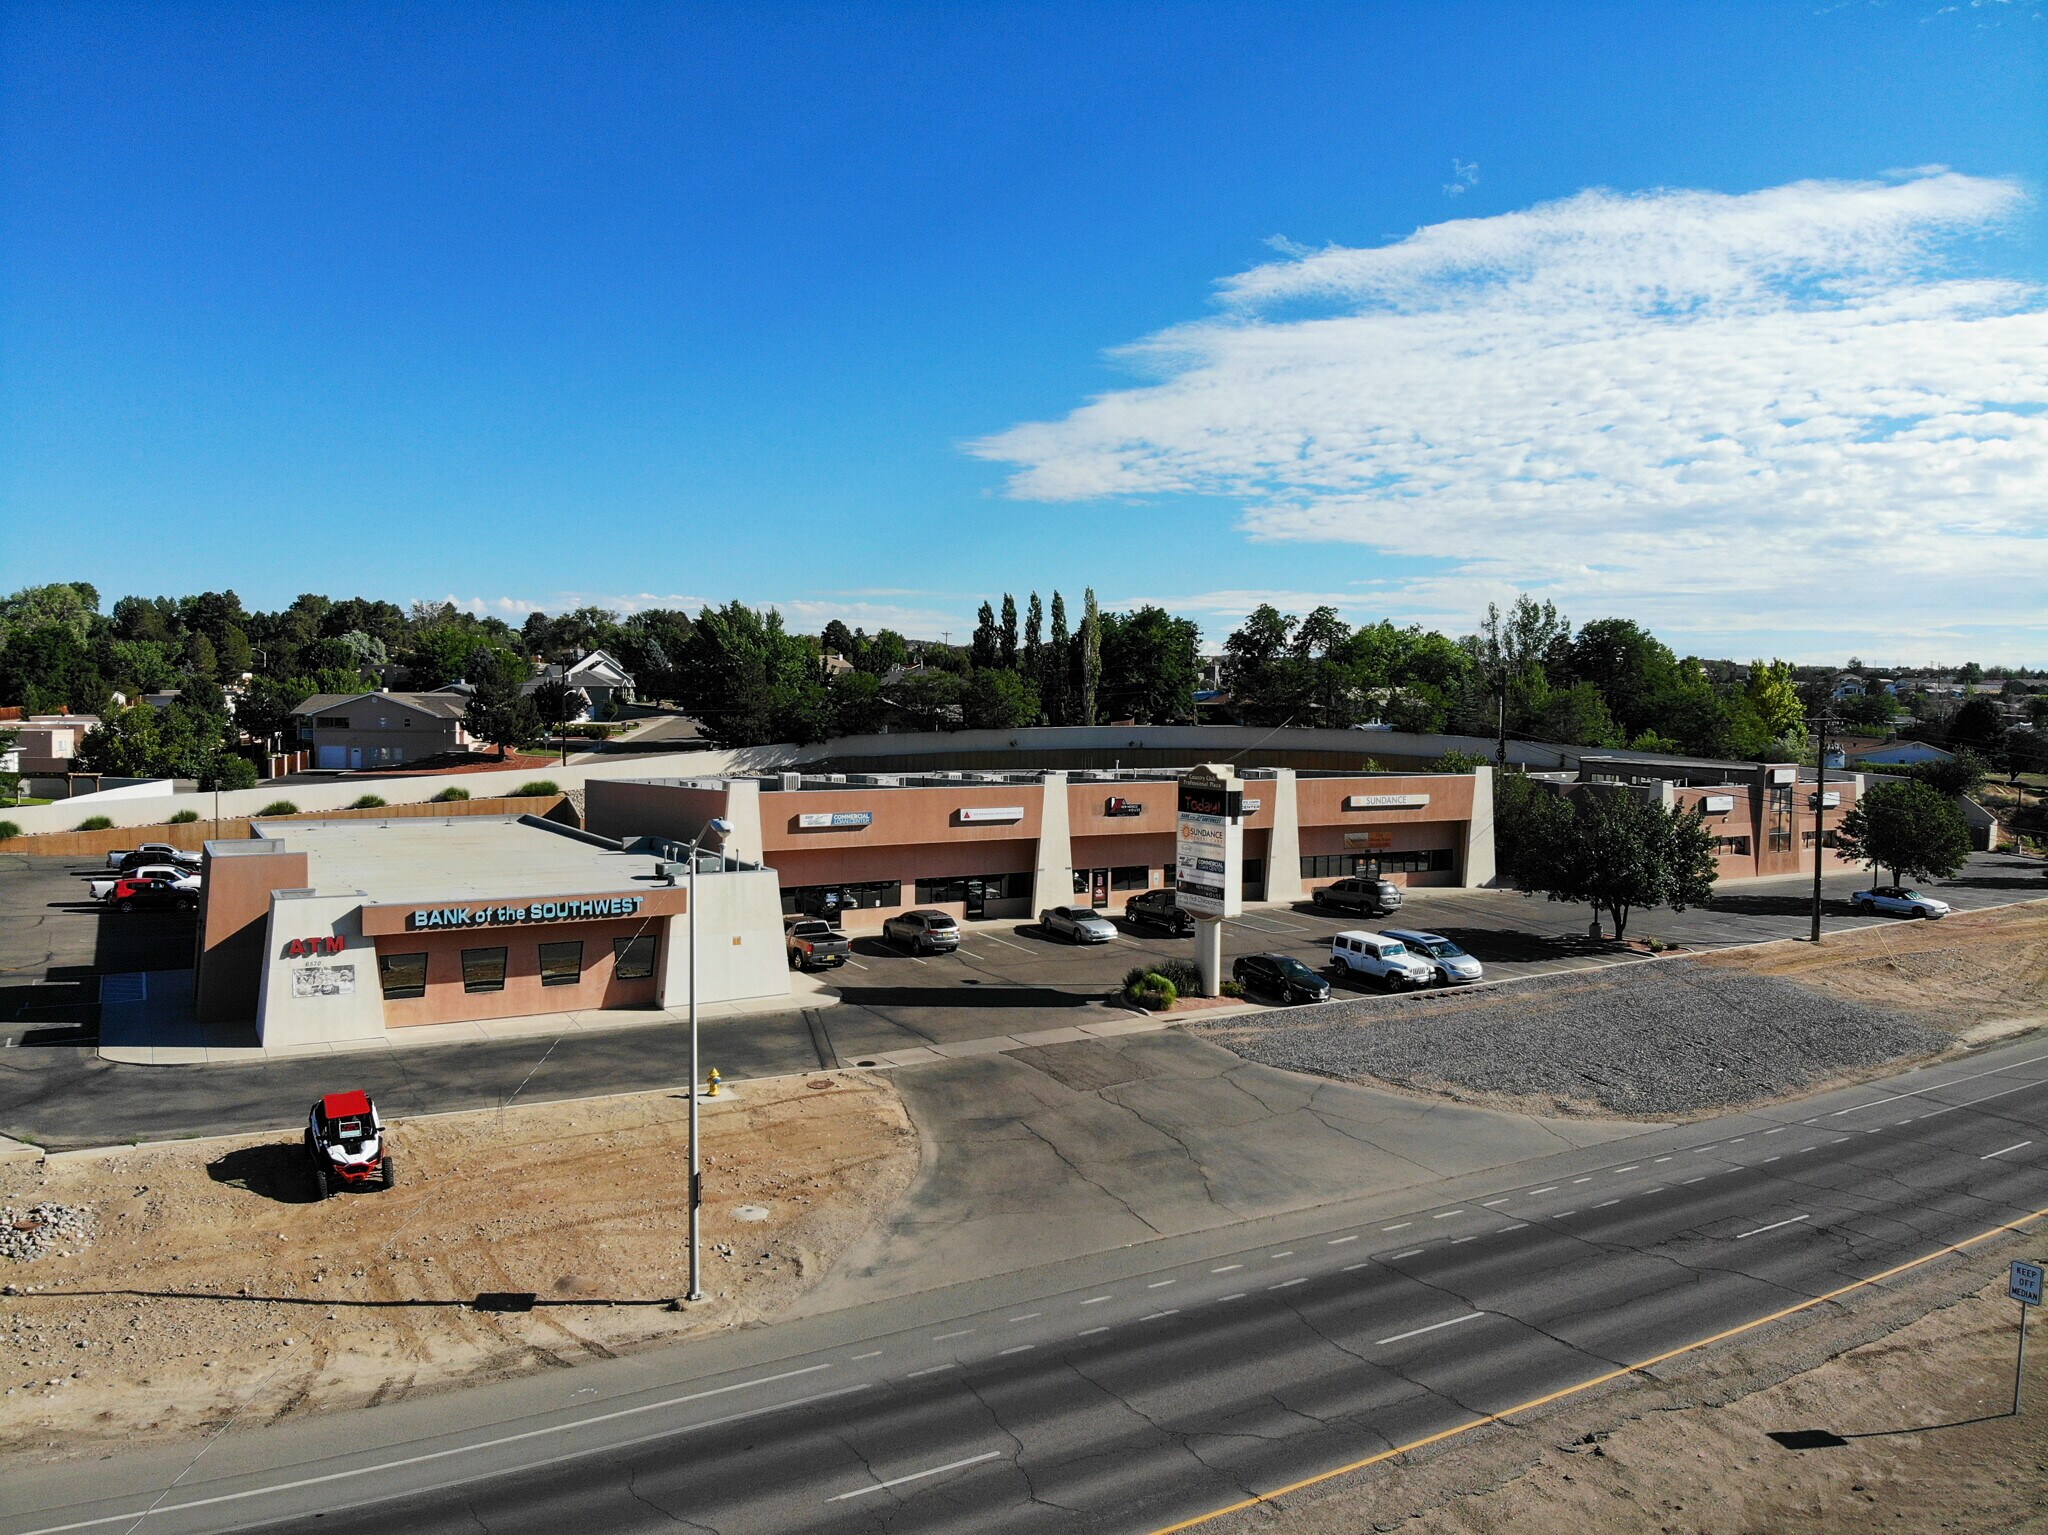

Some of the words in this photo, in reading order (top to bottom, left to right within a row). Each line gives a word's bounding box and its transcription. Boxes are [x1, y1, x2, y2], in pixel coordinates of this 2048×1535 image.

[1366, 796, 1407, 805] SUNDANCE
[1189, 827, 1223, 840] SUNDANCE
[1197, 859, 1224, 868] COMMERCIAL
[415, 907, 471, 927] BANK
[475, 906, 493, 923] of
[497, 905, 526, 922] the
[530, 895, 644, 919] SOUTHWEST
[289, 935, 346, 956] ATM
[2016, 1266, 2037, 1278] KEEP
[2019, 1278, 2034, 1288] OFF
[2011, 1286, 2038, 1301] MEDIAN
